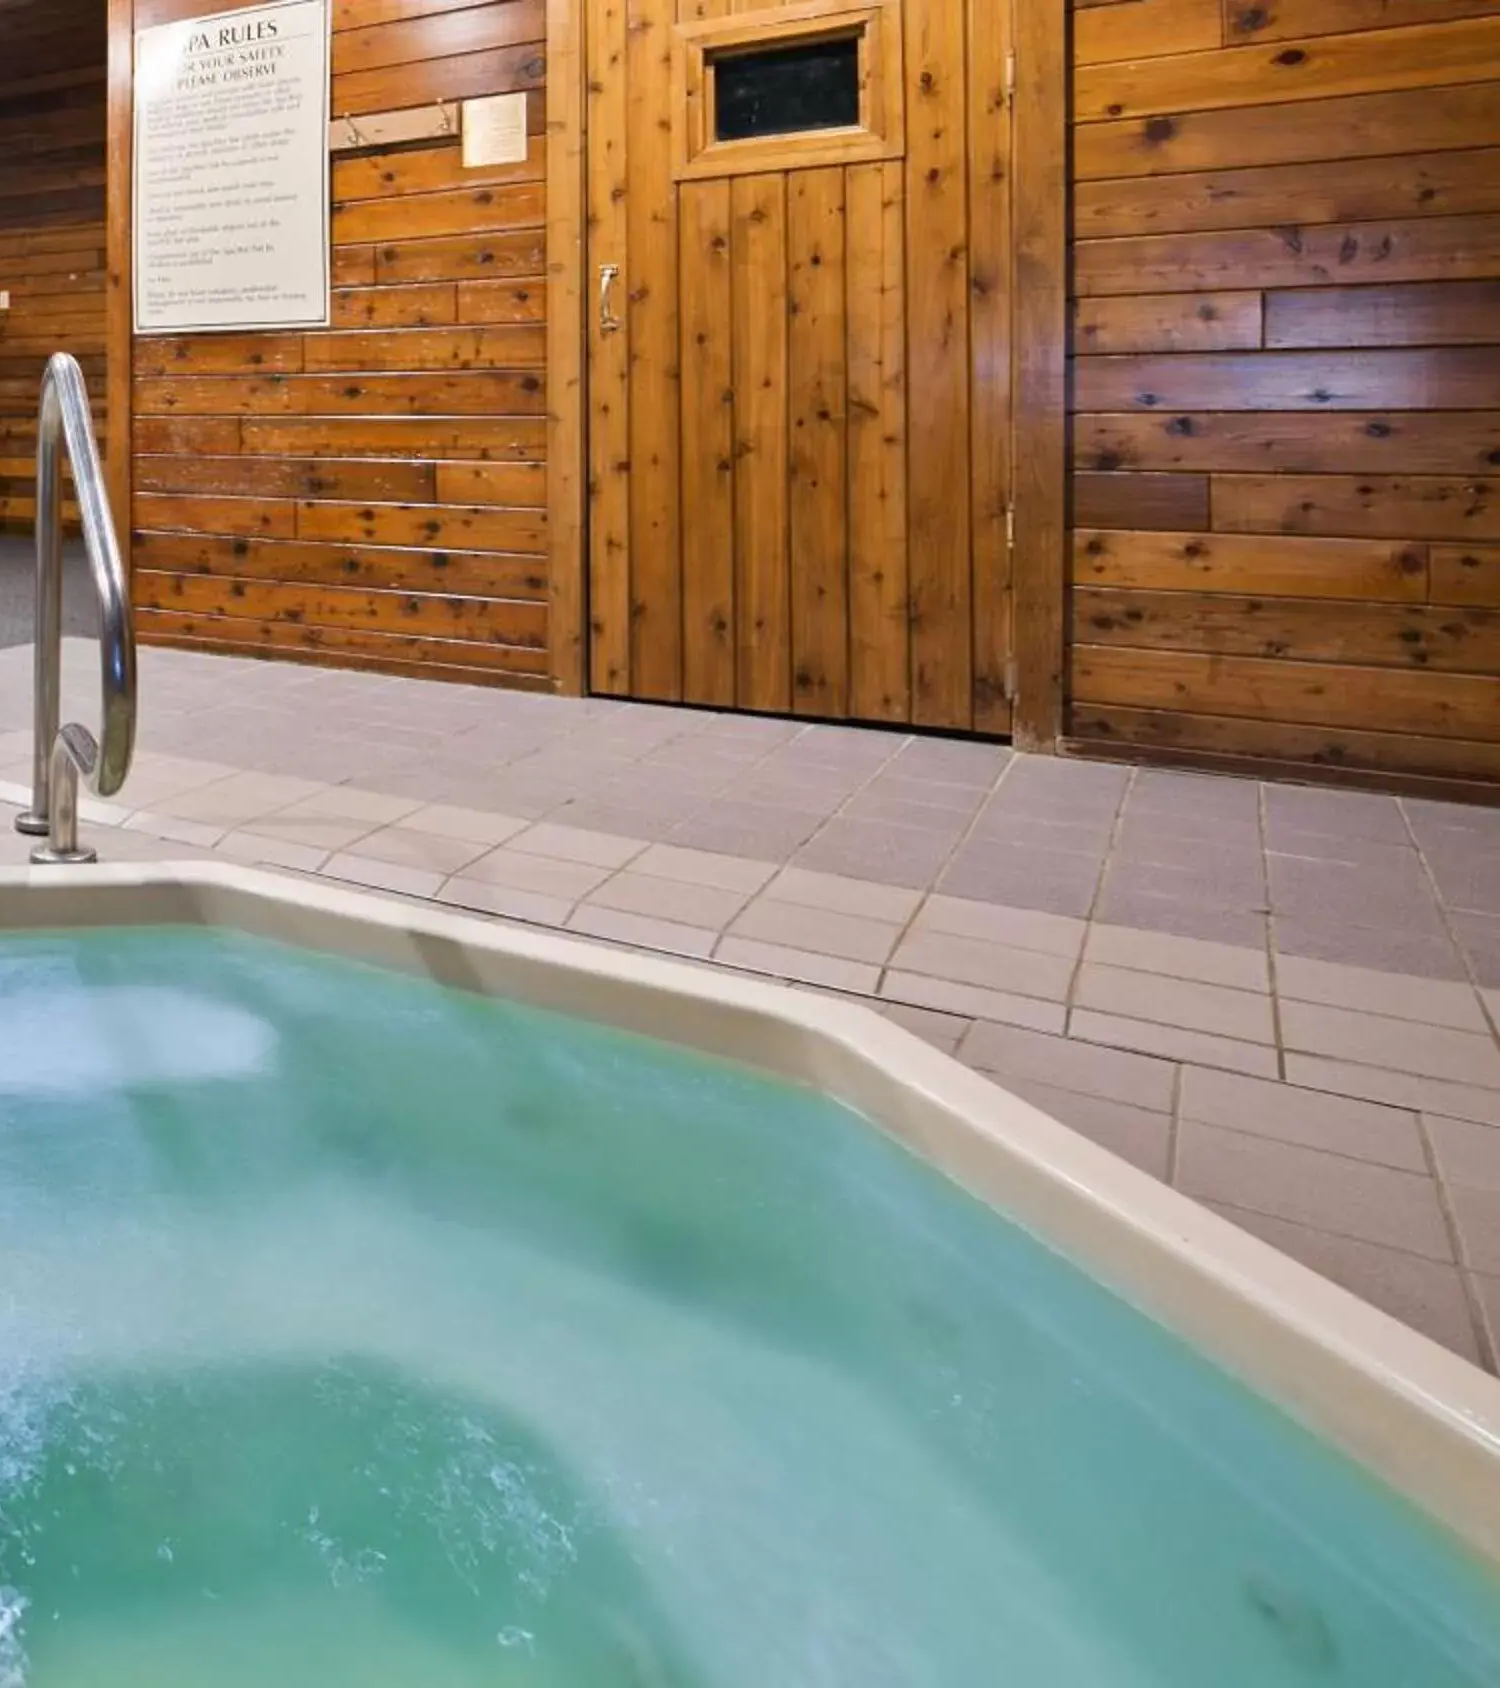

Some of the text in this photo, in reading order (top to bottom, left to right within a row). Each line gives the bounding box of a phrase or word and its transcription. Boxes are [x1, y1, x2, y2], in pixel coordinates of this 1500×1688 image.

[183, 20, 278, 53] PA RULES
[200, 54, 235, 70] YOUR
[239, 45, 285, 62] SAFETY
[176, 73, 216, 91] PLEASE
[223, 62, 276, 82] OBSERVE
